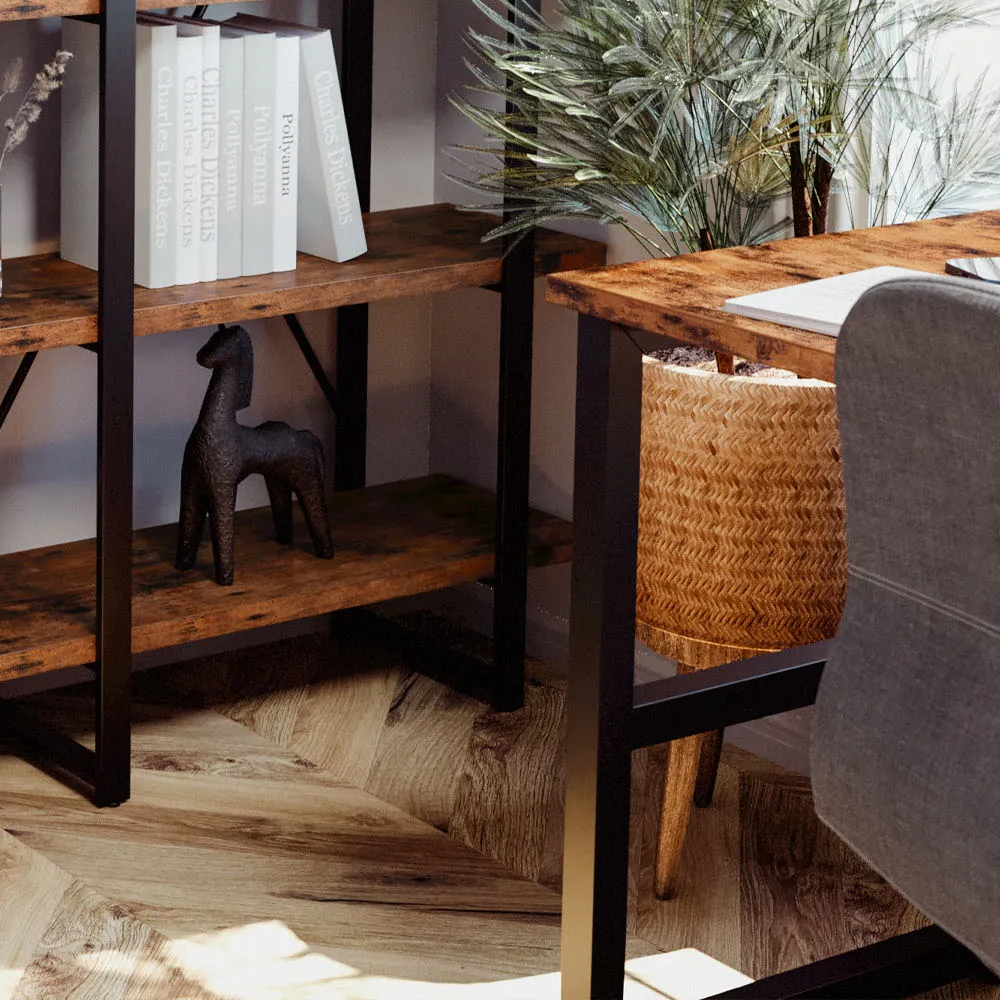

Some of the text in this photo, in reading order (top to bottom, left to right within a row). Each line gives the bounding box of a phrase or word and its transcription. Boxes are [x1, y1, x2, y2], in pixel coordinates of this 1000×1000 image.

[156, 66, 172, 249] Charles Dickens
[182, 75, 198, 248] Charles Dickens
[200, 66, 220, 243] Charles Dickens
[225, 108, 241, 212] Pollyanna
[252, 104, 272, 207] Pollyanna
[278, 113, 294, 197] Pollyanna
[314, 69, 353, 226] Charles Dickens
